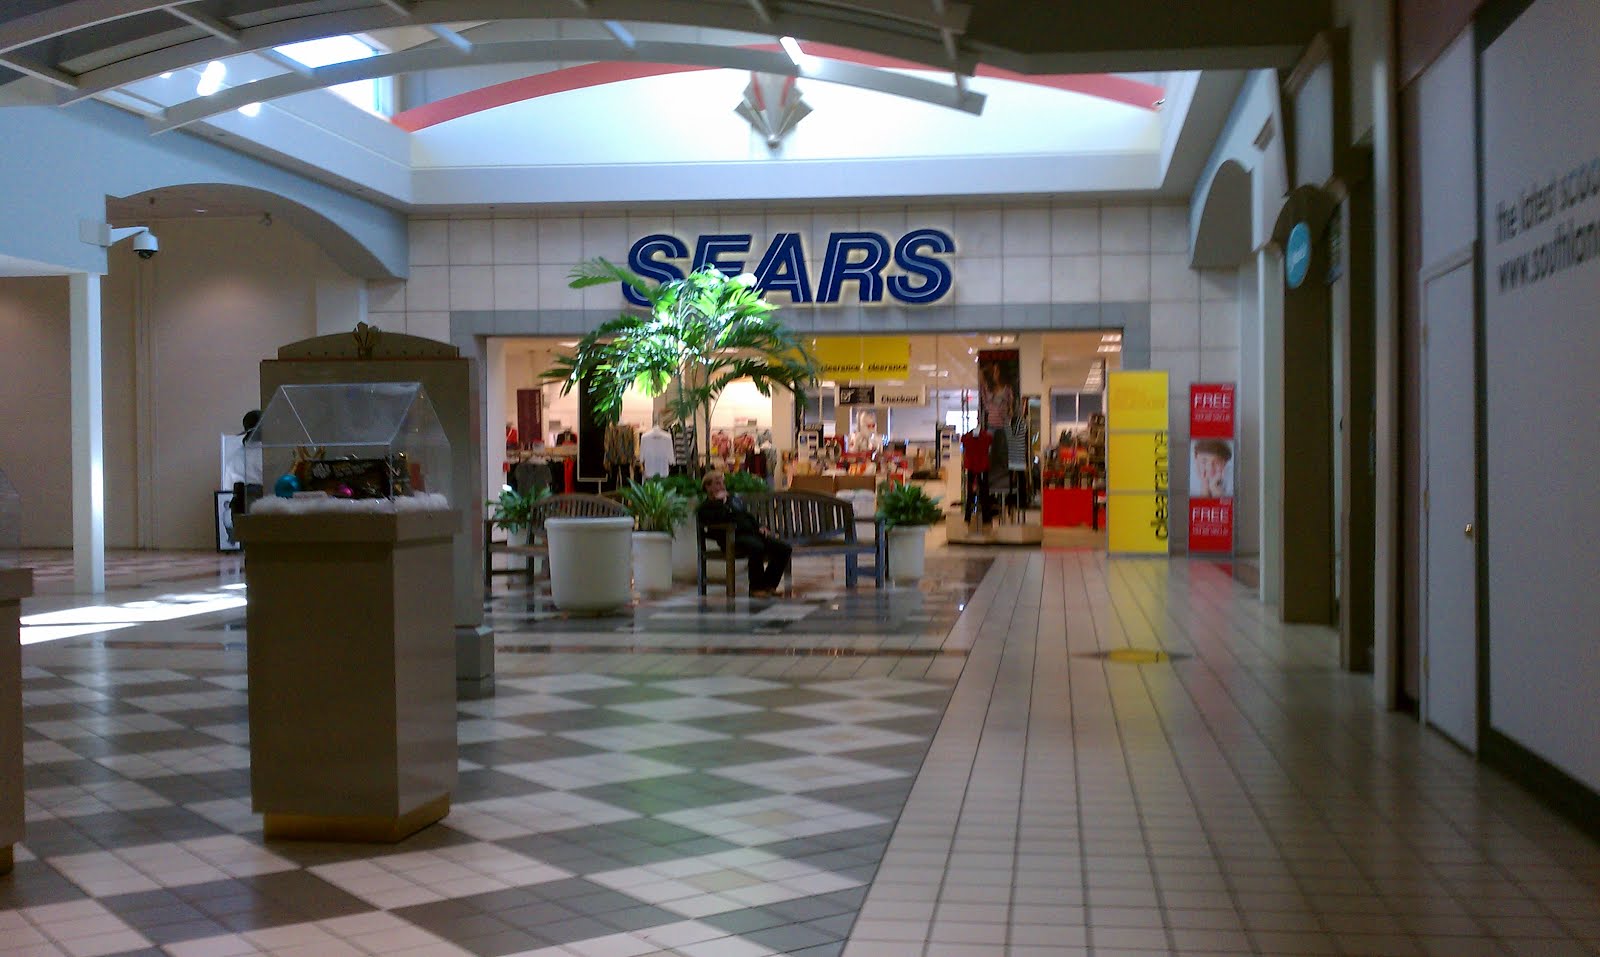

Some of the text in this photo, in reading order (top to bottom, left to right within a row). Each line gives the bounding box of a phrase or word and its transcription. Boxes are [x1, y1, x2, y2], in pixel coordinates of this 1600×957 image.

[622, 229, 955, 307] SEARS
[820, 363, 908, 373] clearance clearance
[881, 394, 919, 404] Checkout
[1194, 392, 1232, 409] FREE
[1192, 507, 1229, 524] FREE
